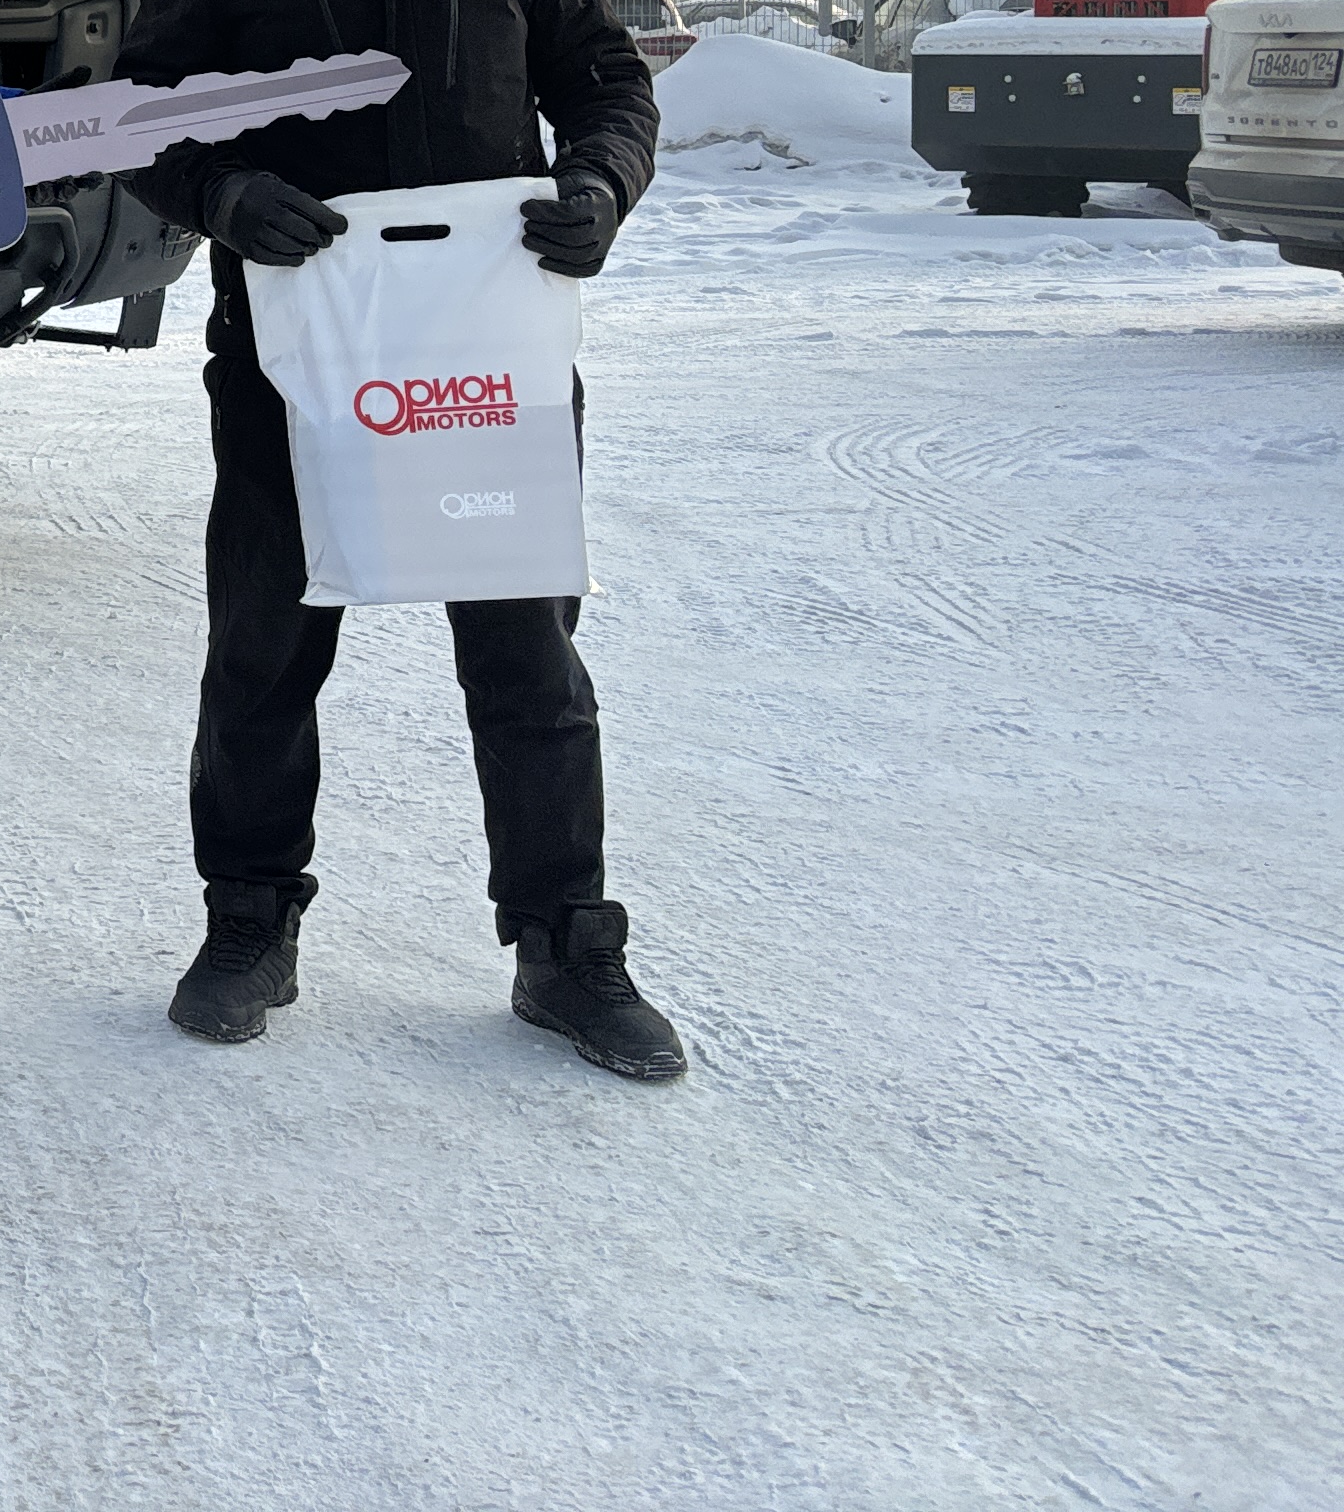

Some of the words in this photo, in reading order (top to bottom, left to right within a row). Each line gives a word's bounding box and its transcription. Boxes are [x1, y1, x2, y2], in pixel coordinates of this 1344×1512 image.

[1312, 52, 1335, 72] 124
[23, 117, 105, 148] KAMAZ
[416, 409, 517, 431] MOTORS
